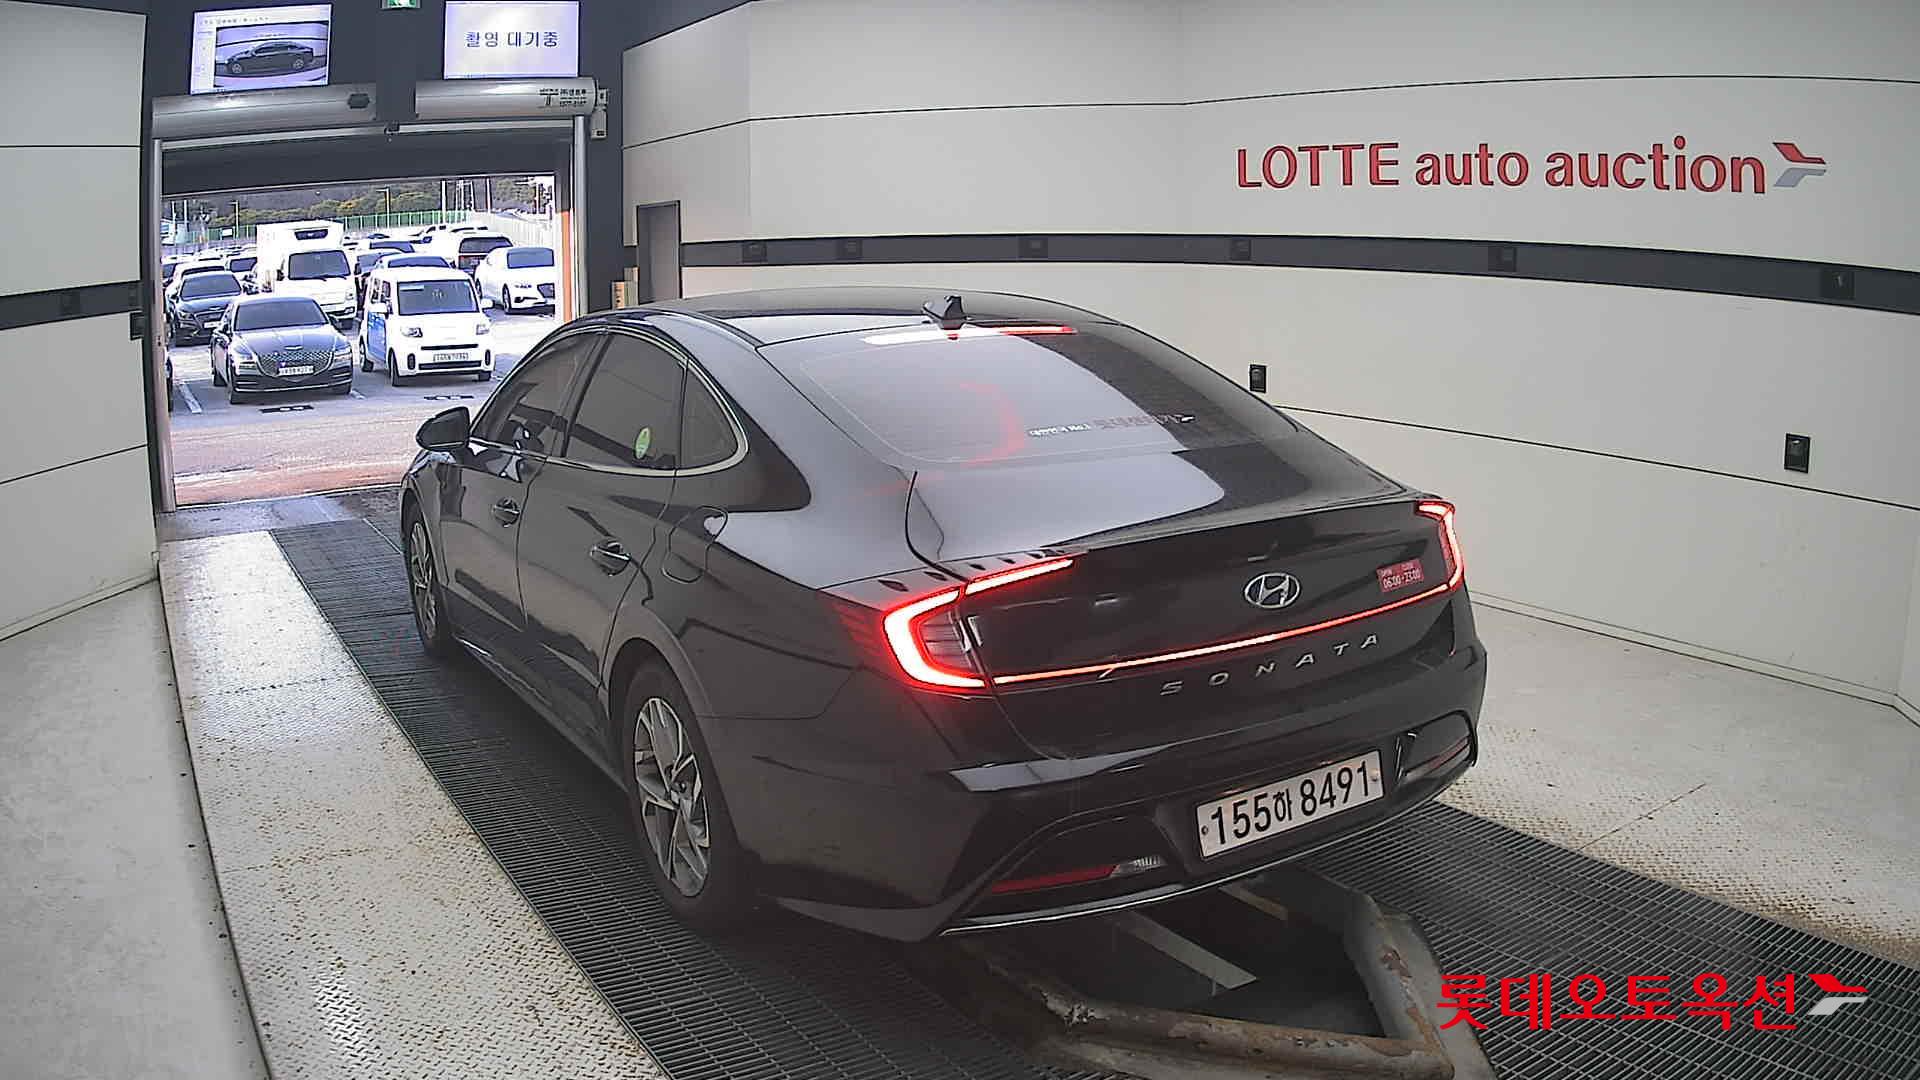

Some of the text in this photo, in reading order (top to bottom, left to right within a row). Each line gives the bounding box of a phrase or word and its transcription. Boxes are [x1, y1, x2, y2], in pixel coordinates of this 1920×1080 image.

[507, 31, 558, 48] 대기중
[1237, 135, 1766, 194] LOTTE auto auction
[1160, 634, 1378, 696] SONATA
[1211, 761, 1369, 844] 155하 8491
